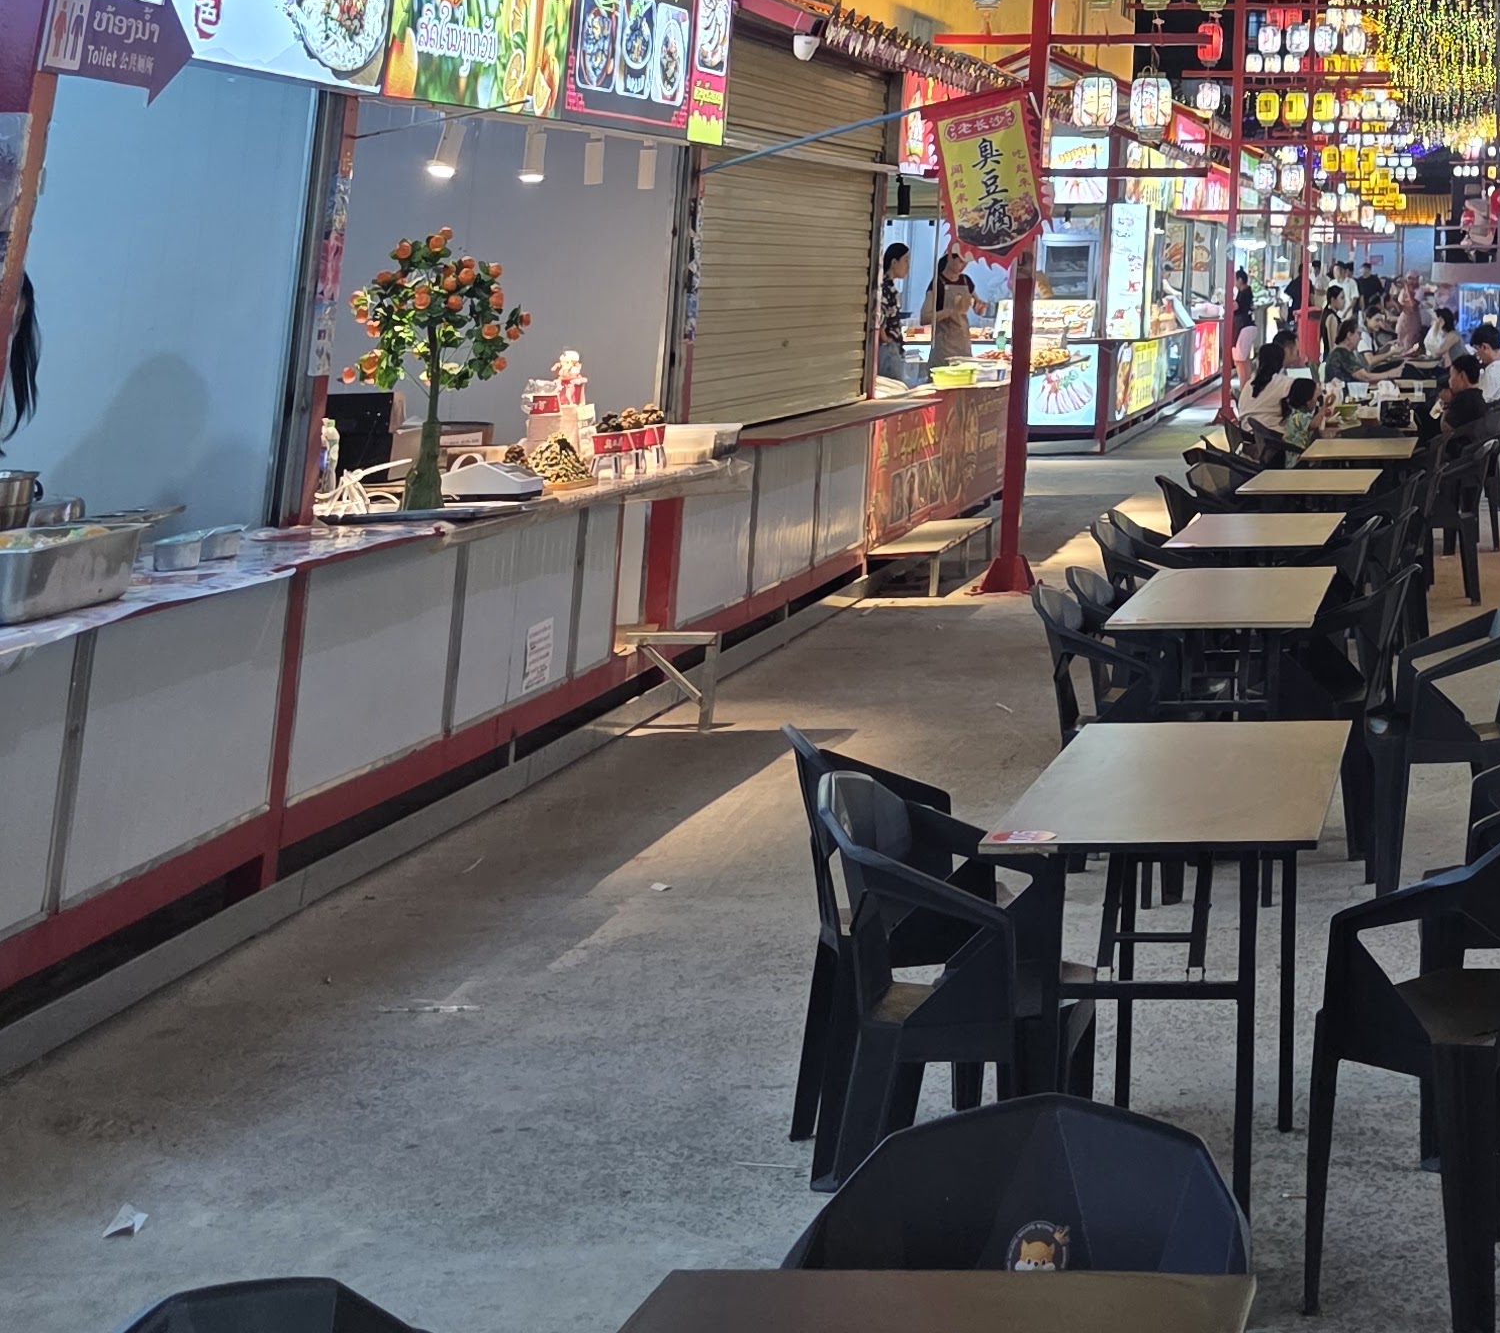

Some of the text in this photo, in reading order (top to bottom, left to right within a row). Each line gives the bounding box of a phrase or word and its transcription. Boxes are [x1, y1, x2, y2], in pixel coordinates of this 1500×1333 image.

[93, 4, 161, 44] ຫ້ອງນ້ຳ
[87, 45, 118, 69] Toilet
[957, 114, 1006, 136] 老长沙
[971, 137, 1016, 235] 臭豆腐
